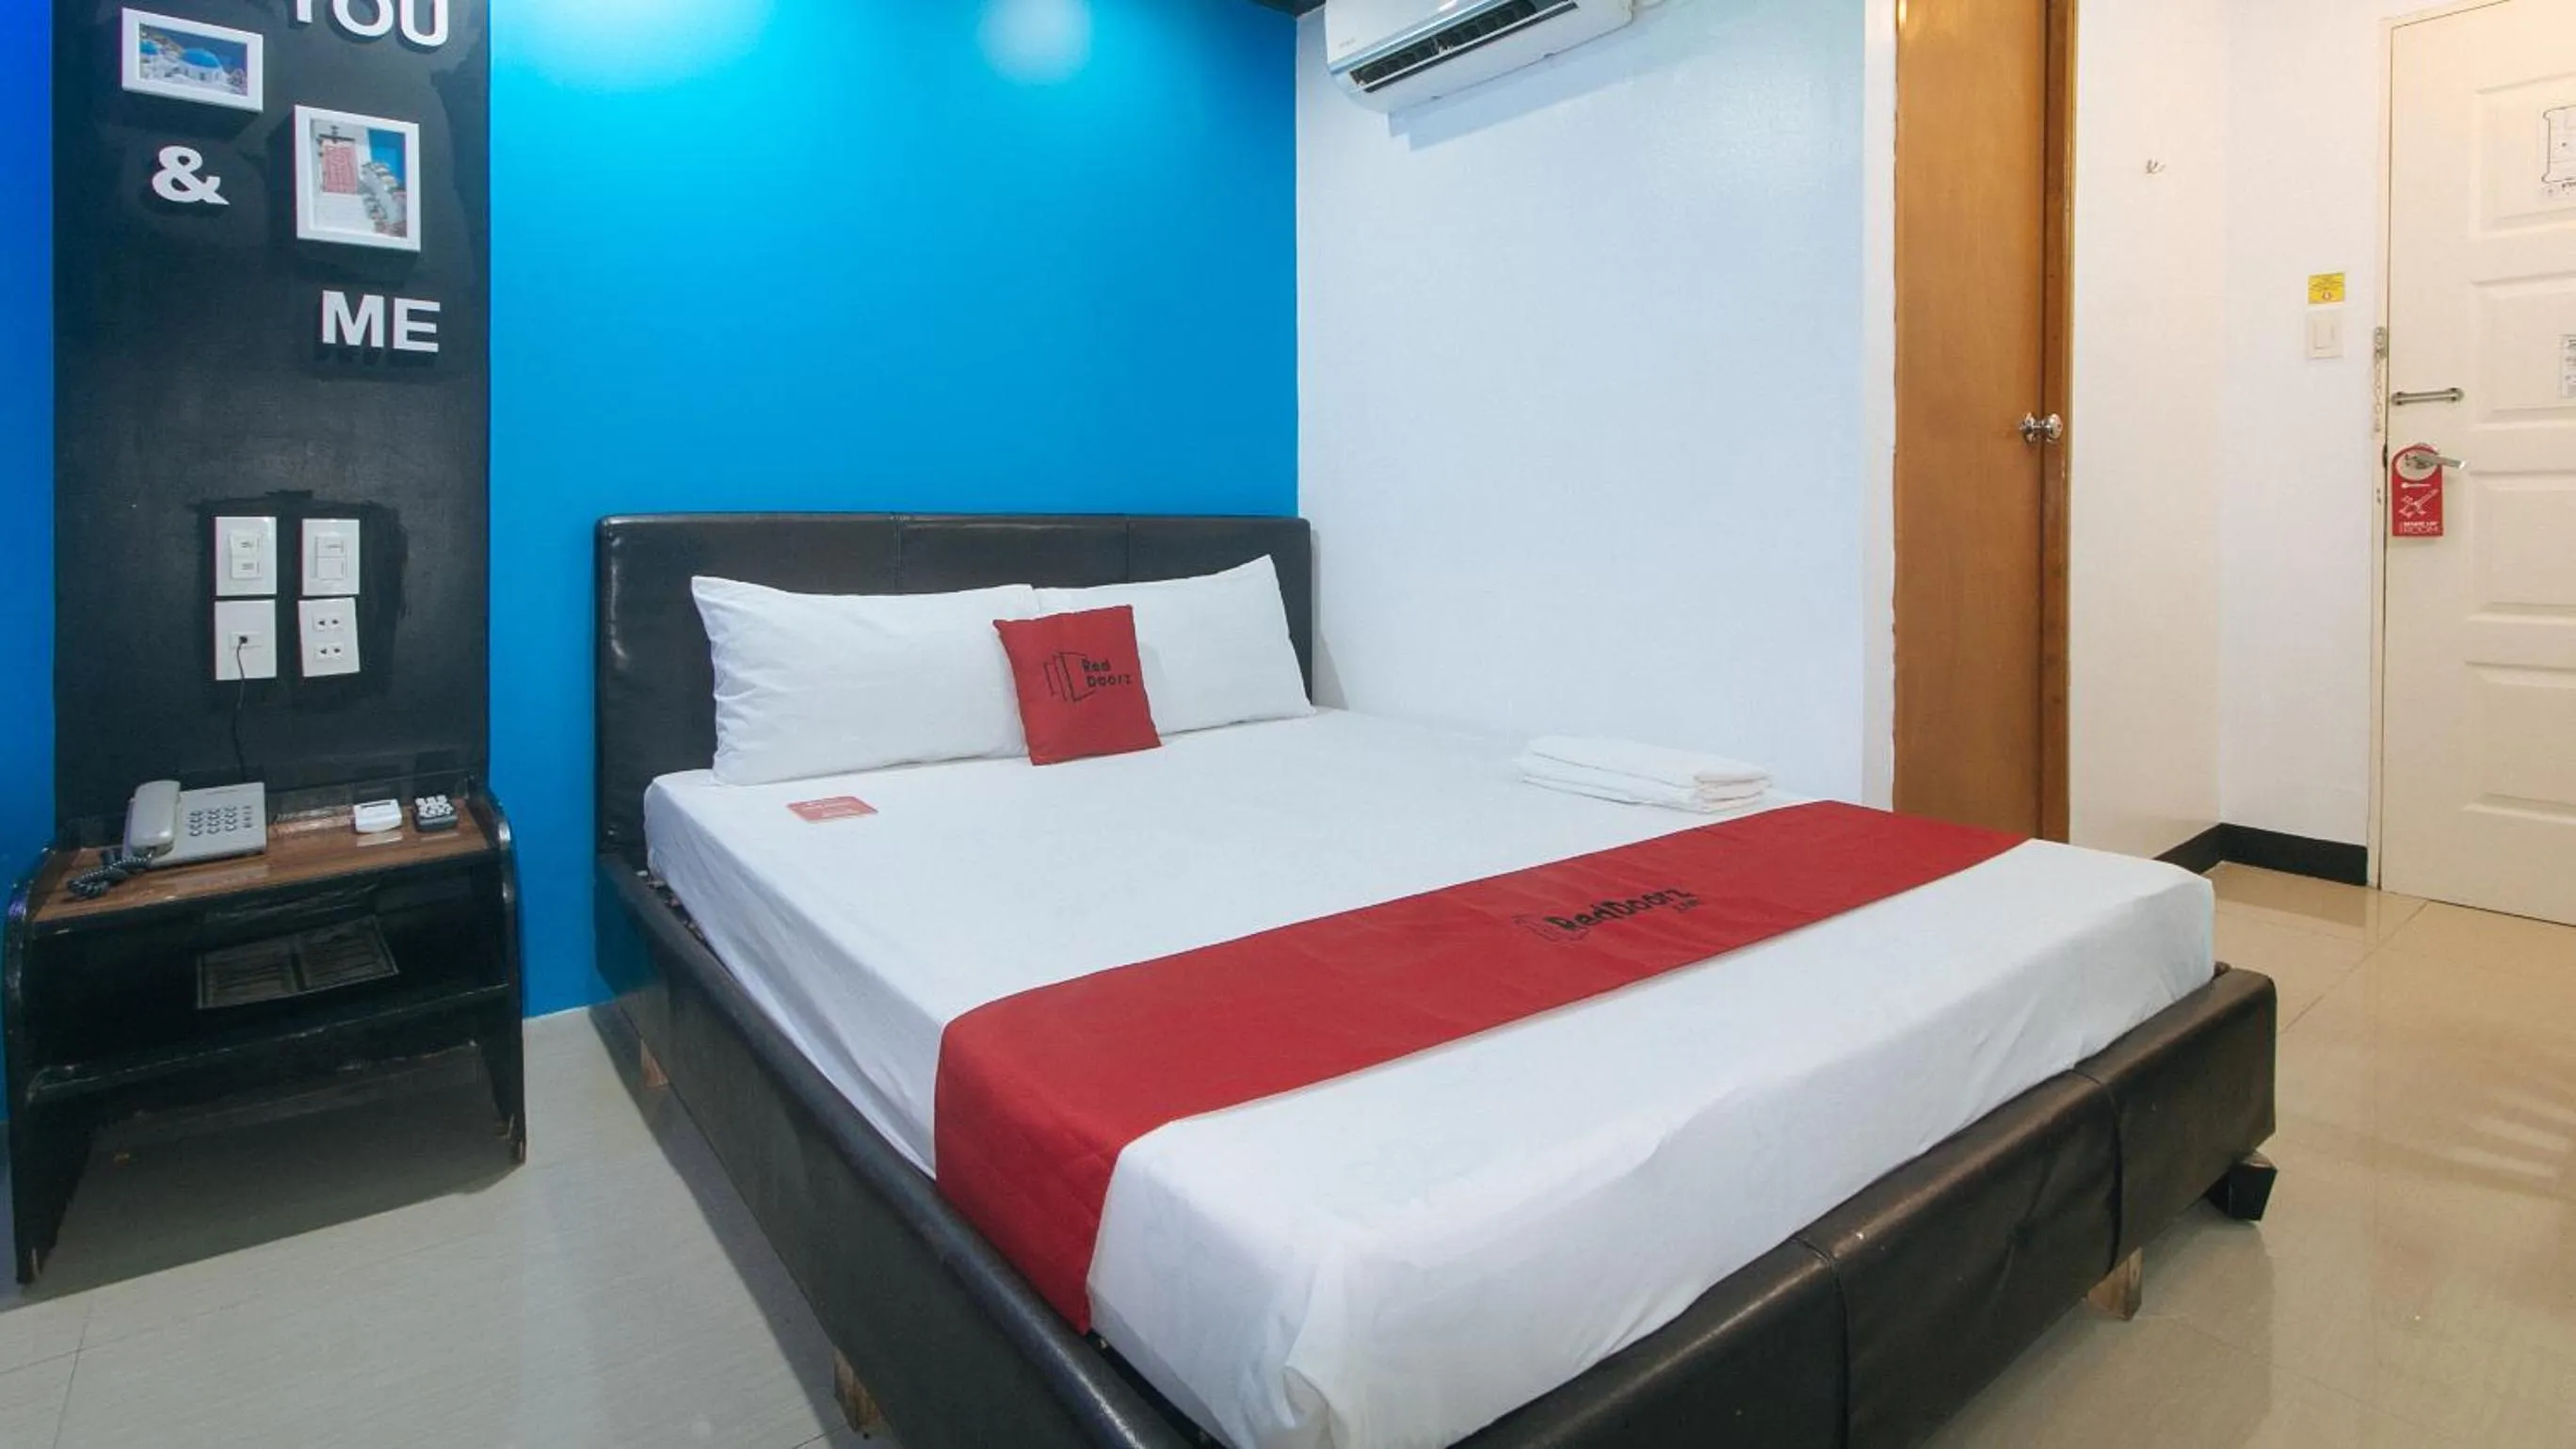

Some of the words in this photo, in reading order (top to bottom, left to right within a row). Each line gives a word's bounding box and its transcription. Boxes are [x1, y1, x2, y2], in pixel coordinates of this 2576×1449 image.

[152, 145, 230, 205] &
[322, 290, 441, 352] ME
[1082, 658, 1111, 673] Red
[1087, 673, 1132, 688] Doorz
